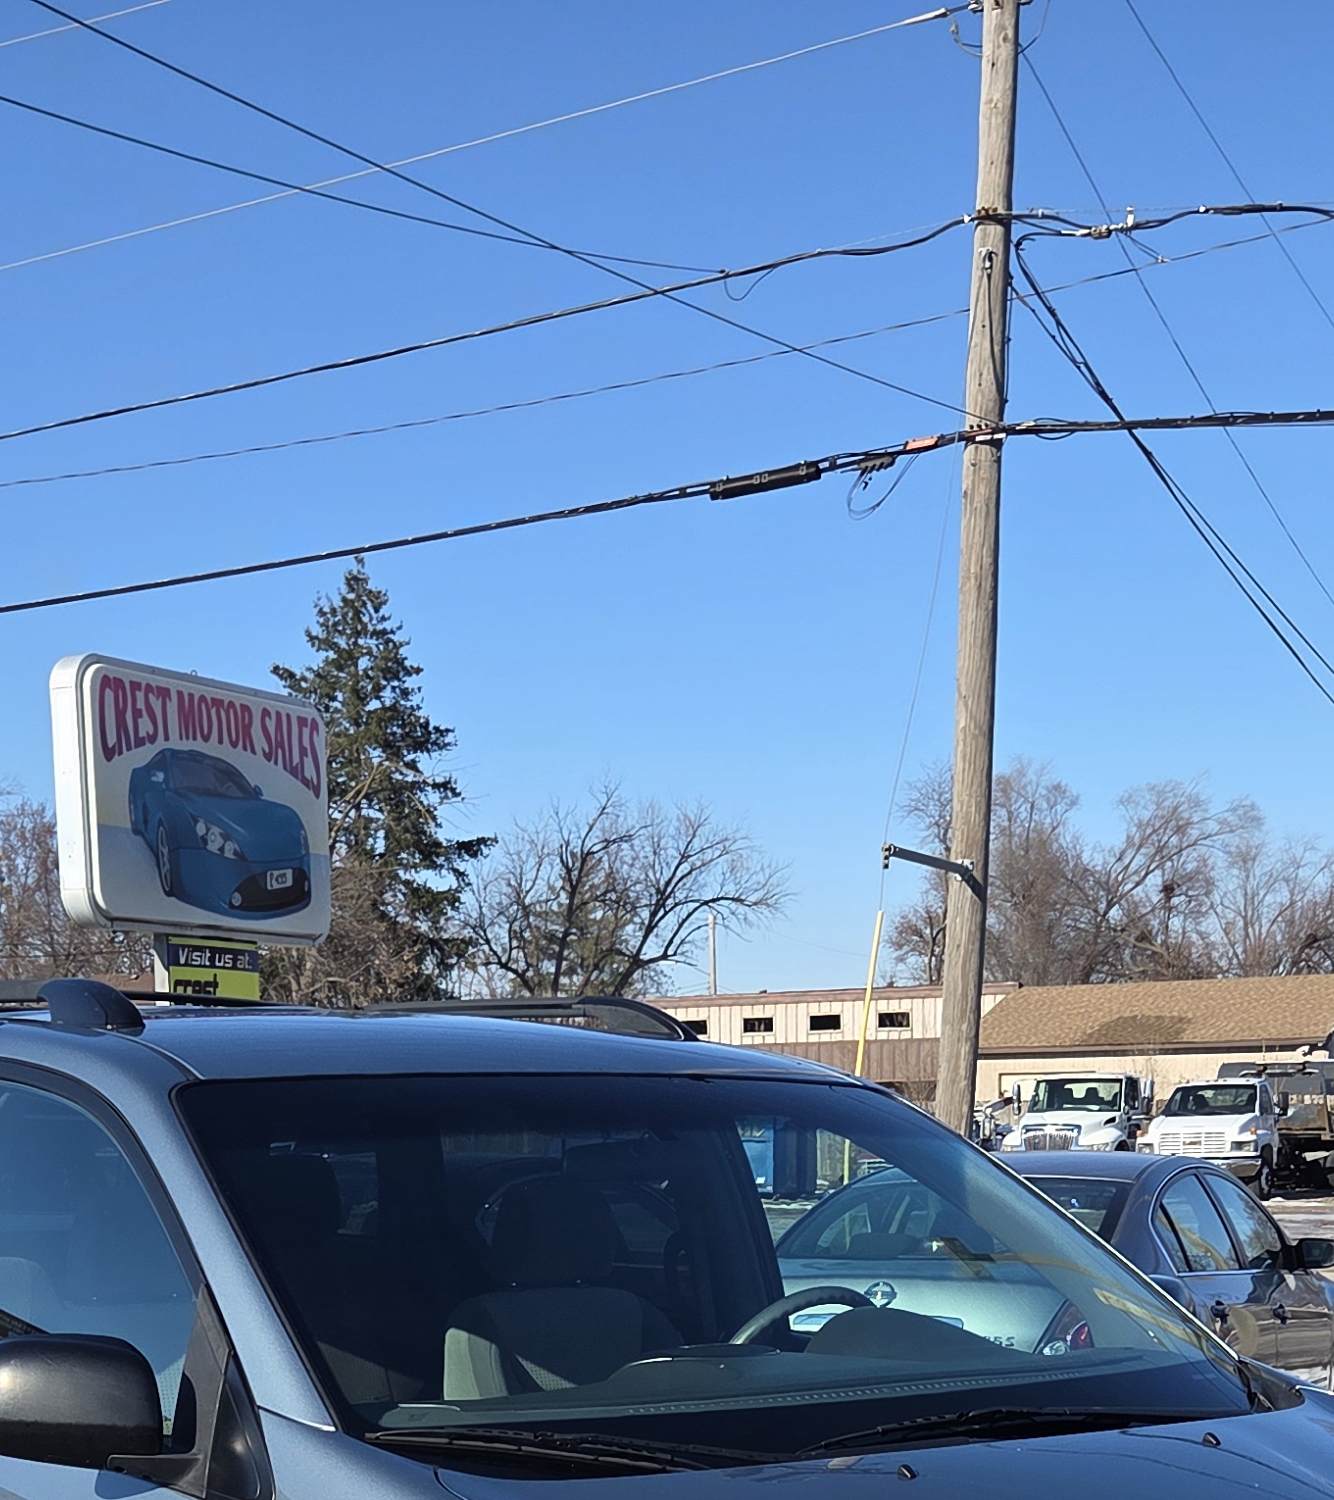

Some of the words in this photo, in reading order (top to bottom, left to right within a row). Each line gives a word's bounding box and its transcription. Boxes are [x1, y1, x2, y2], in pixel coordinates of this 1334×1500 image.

[98, 674, 171, 762] CREST
[176, 689, 257, 756] MOTOR
[260, 706, 322, 800] SALES
[179, 947, 211, 966] Visit
[215, 953, 234, 968] us
